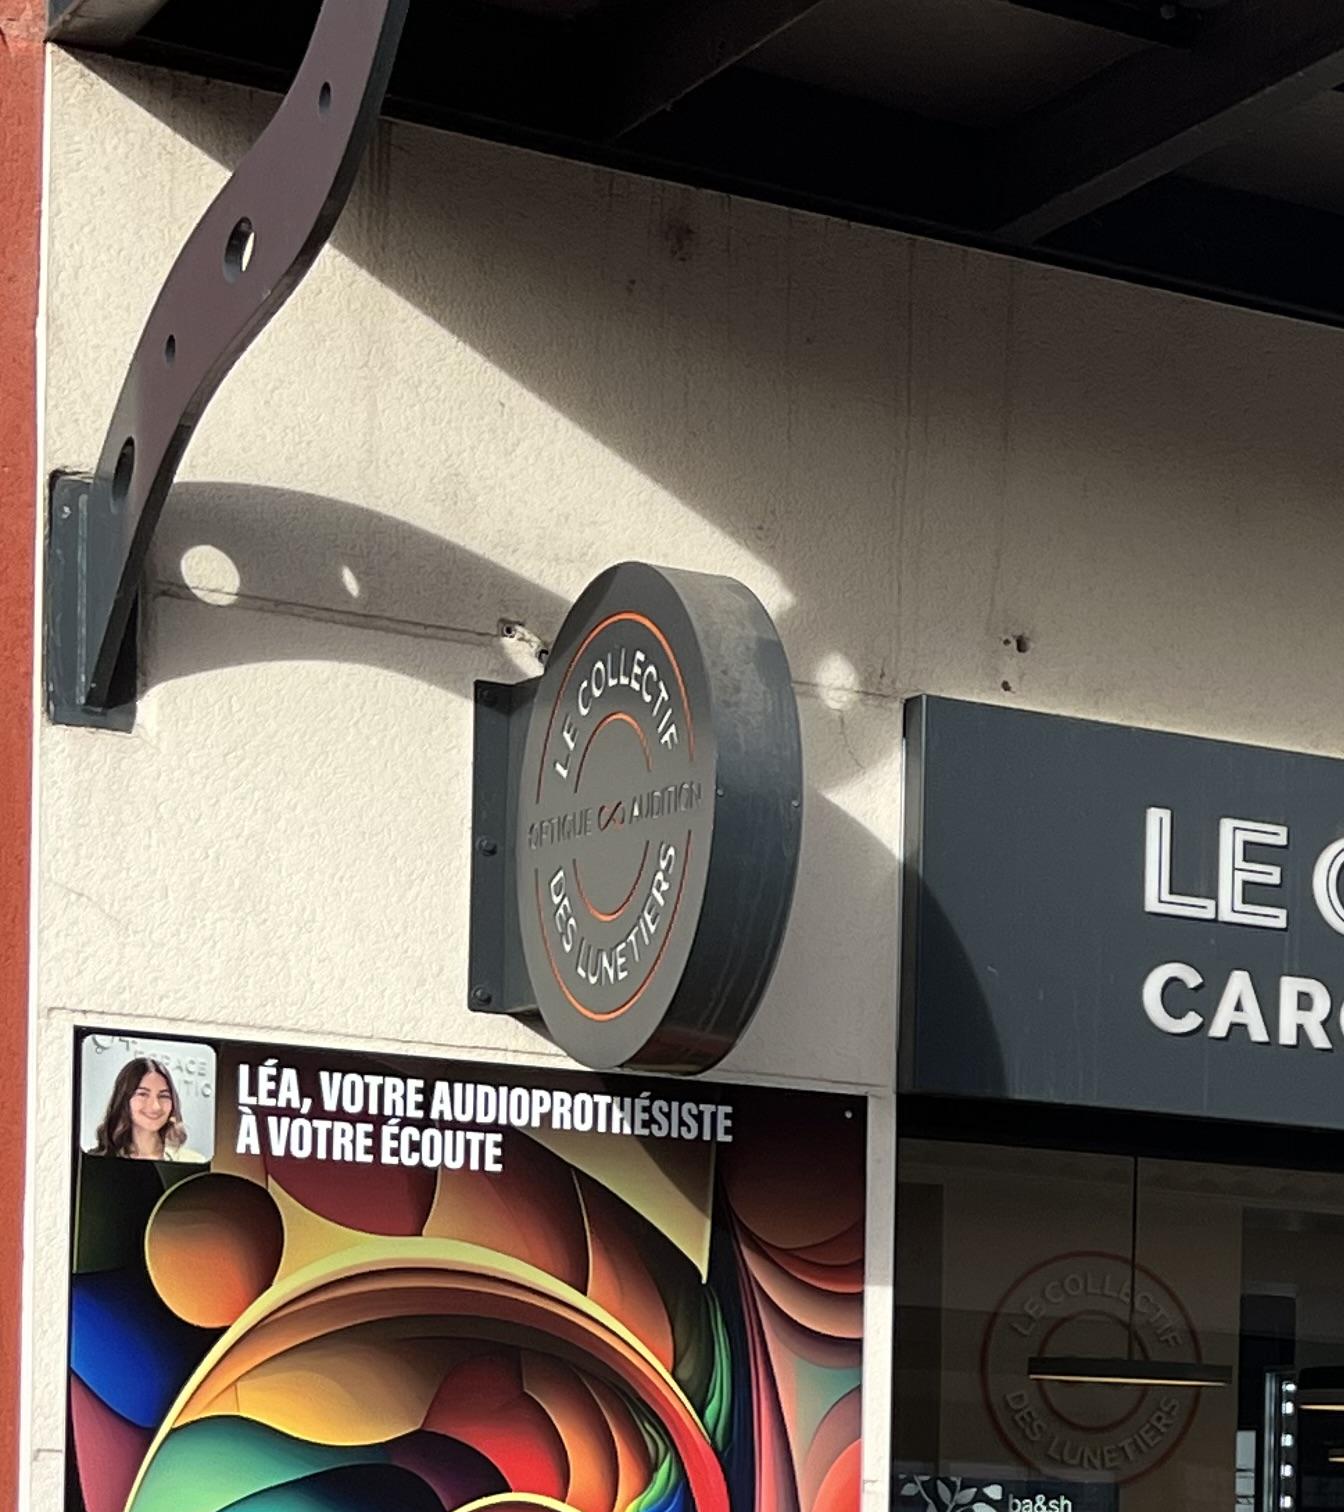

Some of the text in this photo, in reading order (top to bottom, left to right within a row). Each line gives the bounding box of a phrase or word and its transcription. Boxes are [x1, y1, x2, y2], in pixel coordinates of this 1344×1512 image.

[555, 647, 679, 780] LE COLLECTIF
[628, 781, 704, 824] AUDITION
[1145, 807, 1288, 929] LE
[548, 841, 676, 986] DES LUNETIERS
[236, 1107, 502, 1172] À VOTRE ÉCOUTE
[237, 1059, 733, 1142] LÉA, VOTRE AUDIOPROTHÉSISTE
[1011, 1272, 1184, 1349] LE COLLECTIF
[1004, 1391, 1180, 1470] DES LUNETIERS
